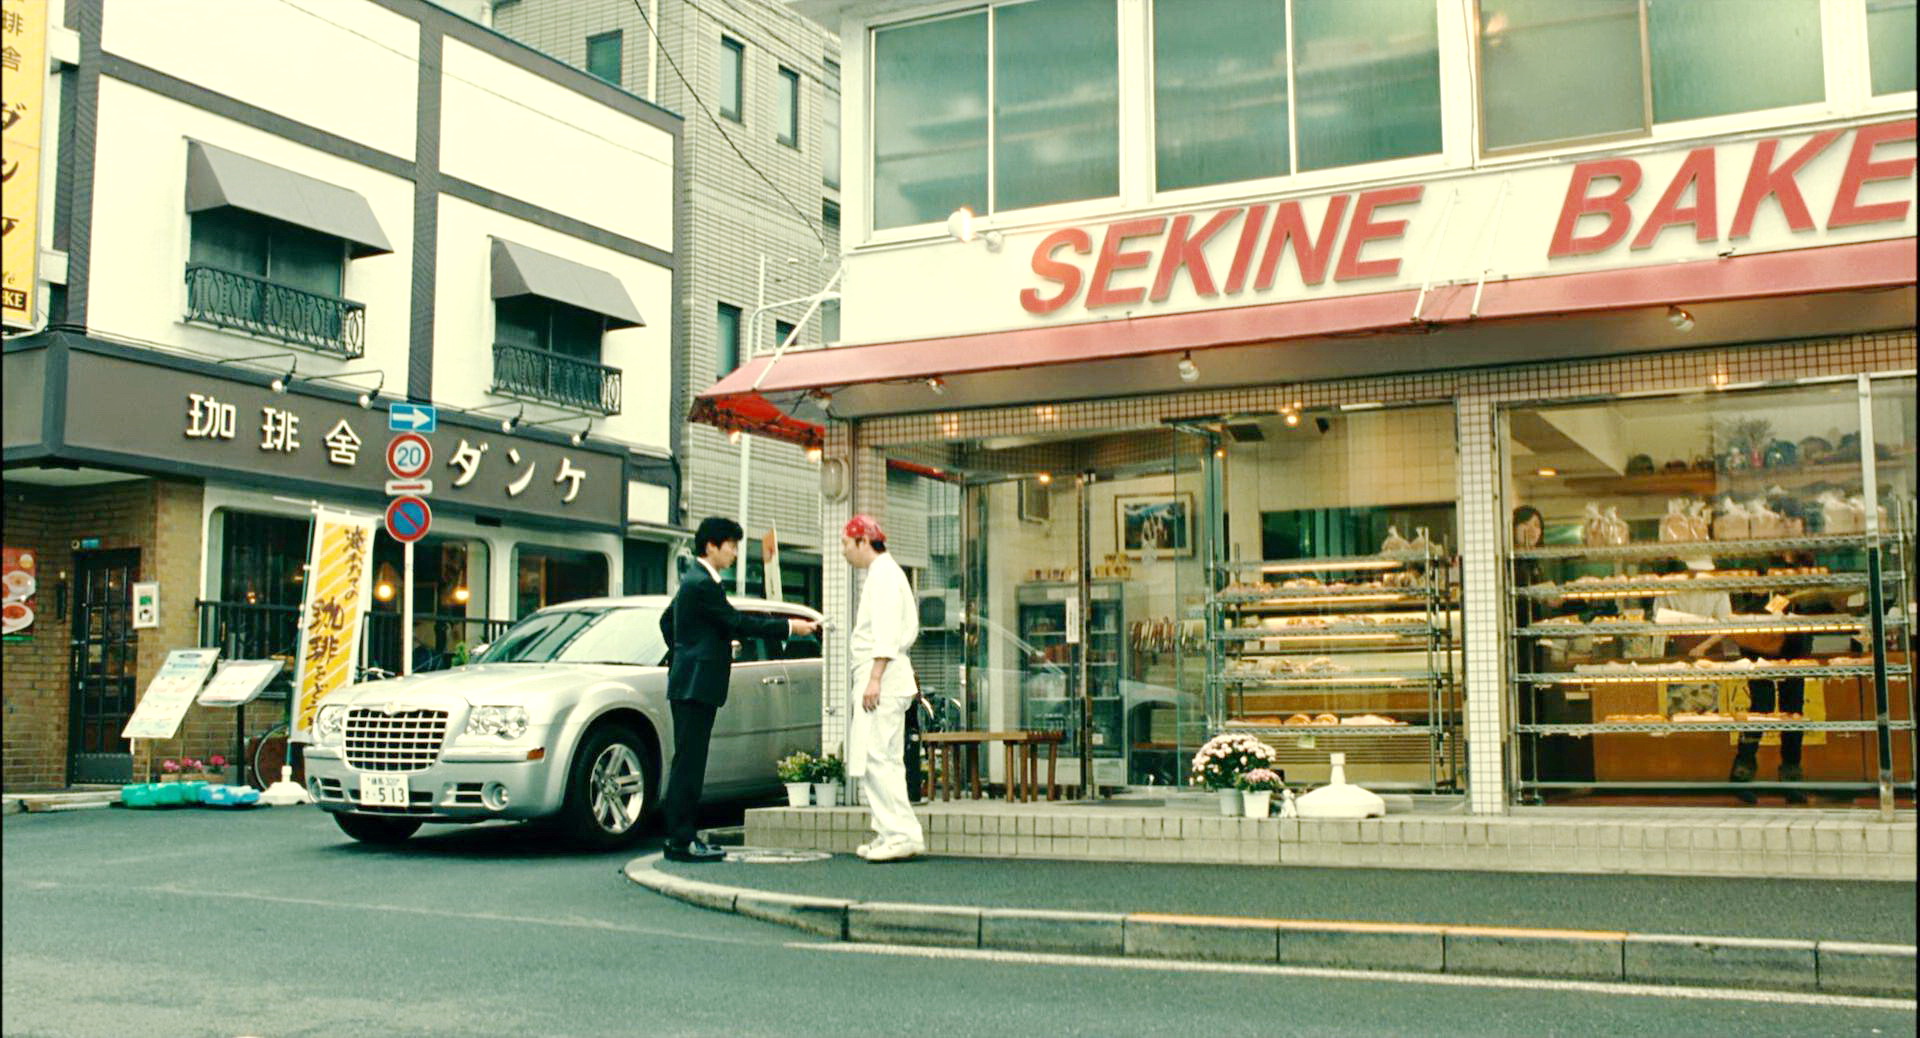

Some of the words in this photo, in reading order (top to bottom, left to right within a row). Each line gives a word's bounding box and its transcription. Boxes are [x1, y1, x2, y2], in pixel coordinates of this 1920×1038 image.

[1020, 184, 1426, 315] SEKINE
[1547, 118, 1917, 261] BAKE
[185, 392, 362, 467] 珈琲舎
[448, 439, 587, 505] ダンケ
[397, 447, 422, 467] 20
